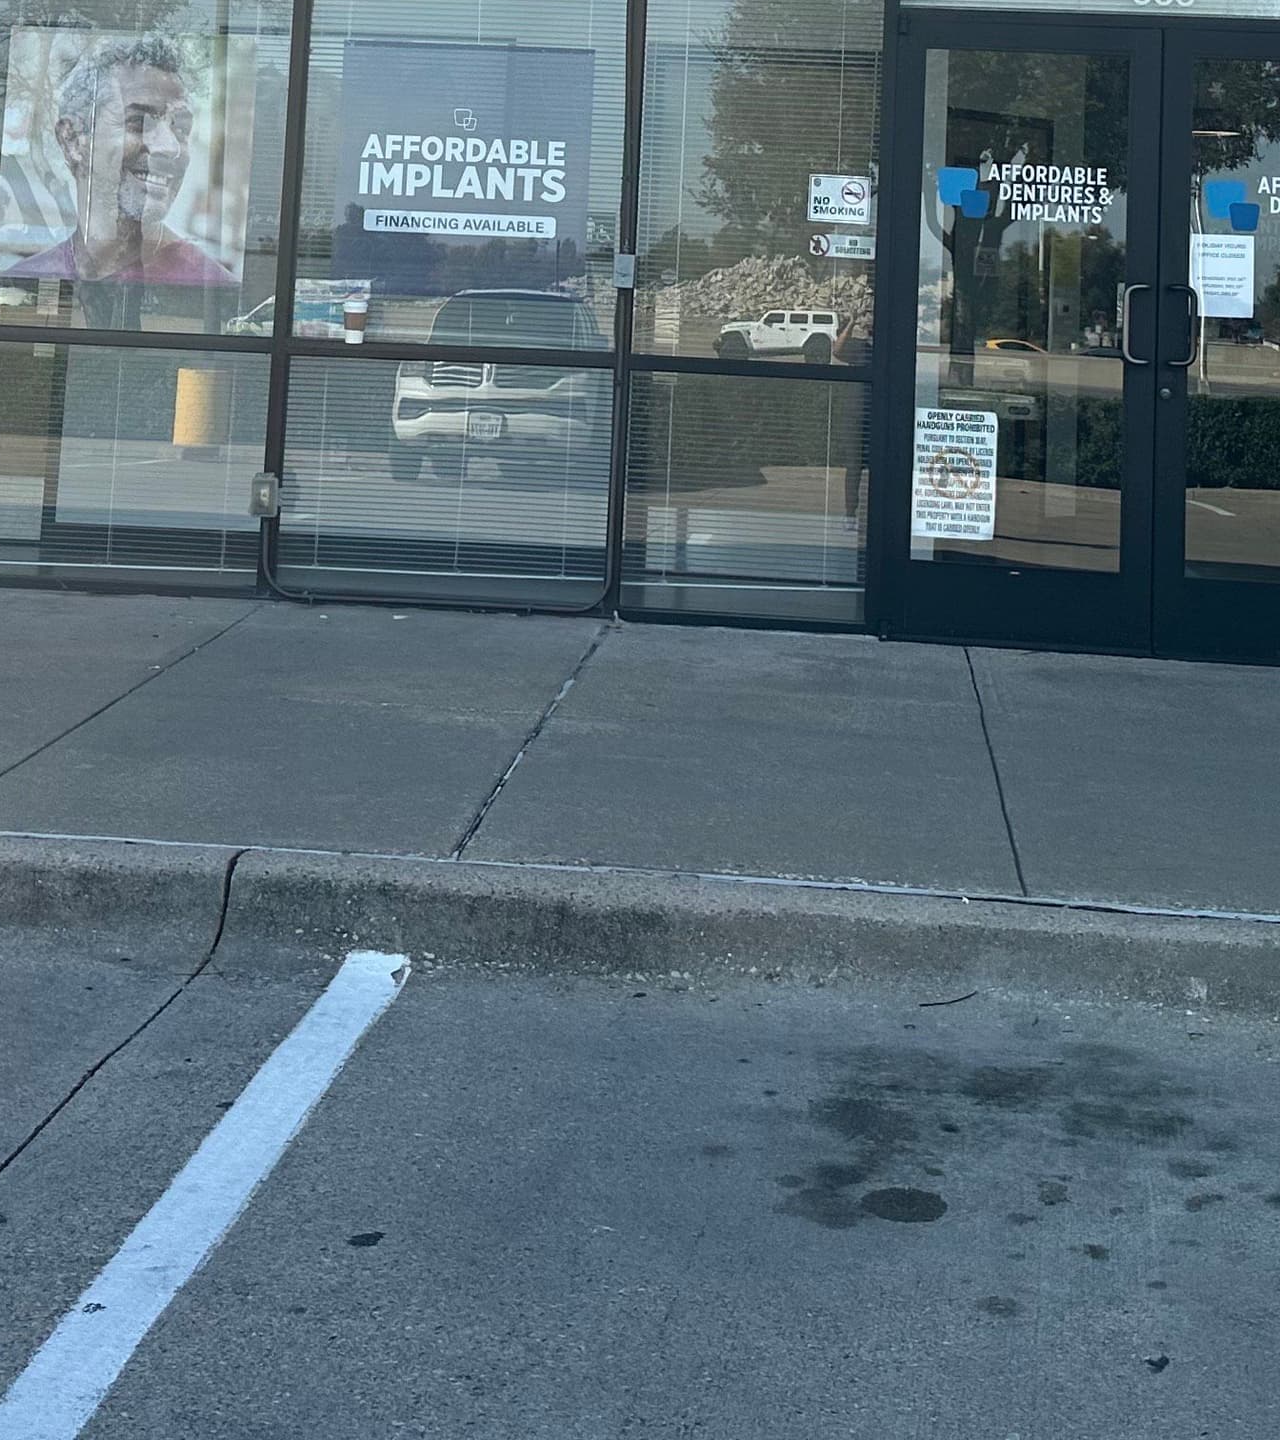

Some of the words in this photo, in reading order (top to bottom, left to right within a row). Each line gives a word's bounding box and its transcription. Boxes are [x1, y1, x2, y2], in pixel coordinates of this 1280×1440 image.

[361, 133, 566, 166] AFFORDABLE
[358, 162, 566, 203] IMPLANTS
[987, 163, 1108, 186] AFFORDABLE
[813, 196, 830, 205] NO
[999, 183, 1095, 204] DENTURES
[1099, 187, 1114, 205] &
[813, 206, 865, 216] SMOKING
[375, 215, 459, 230] FINANCING
[463, 220, 544, 233] AVAILABLE
